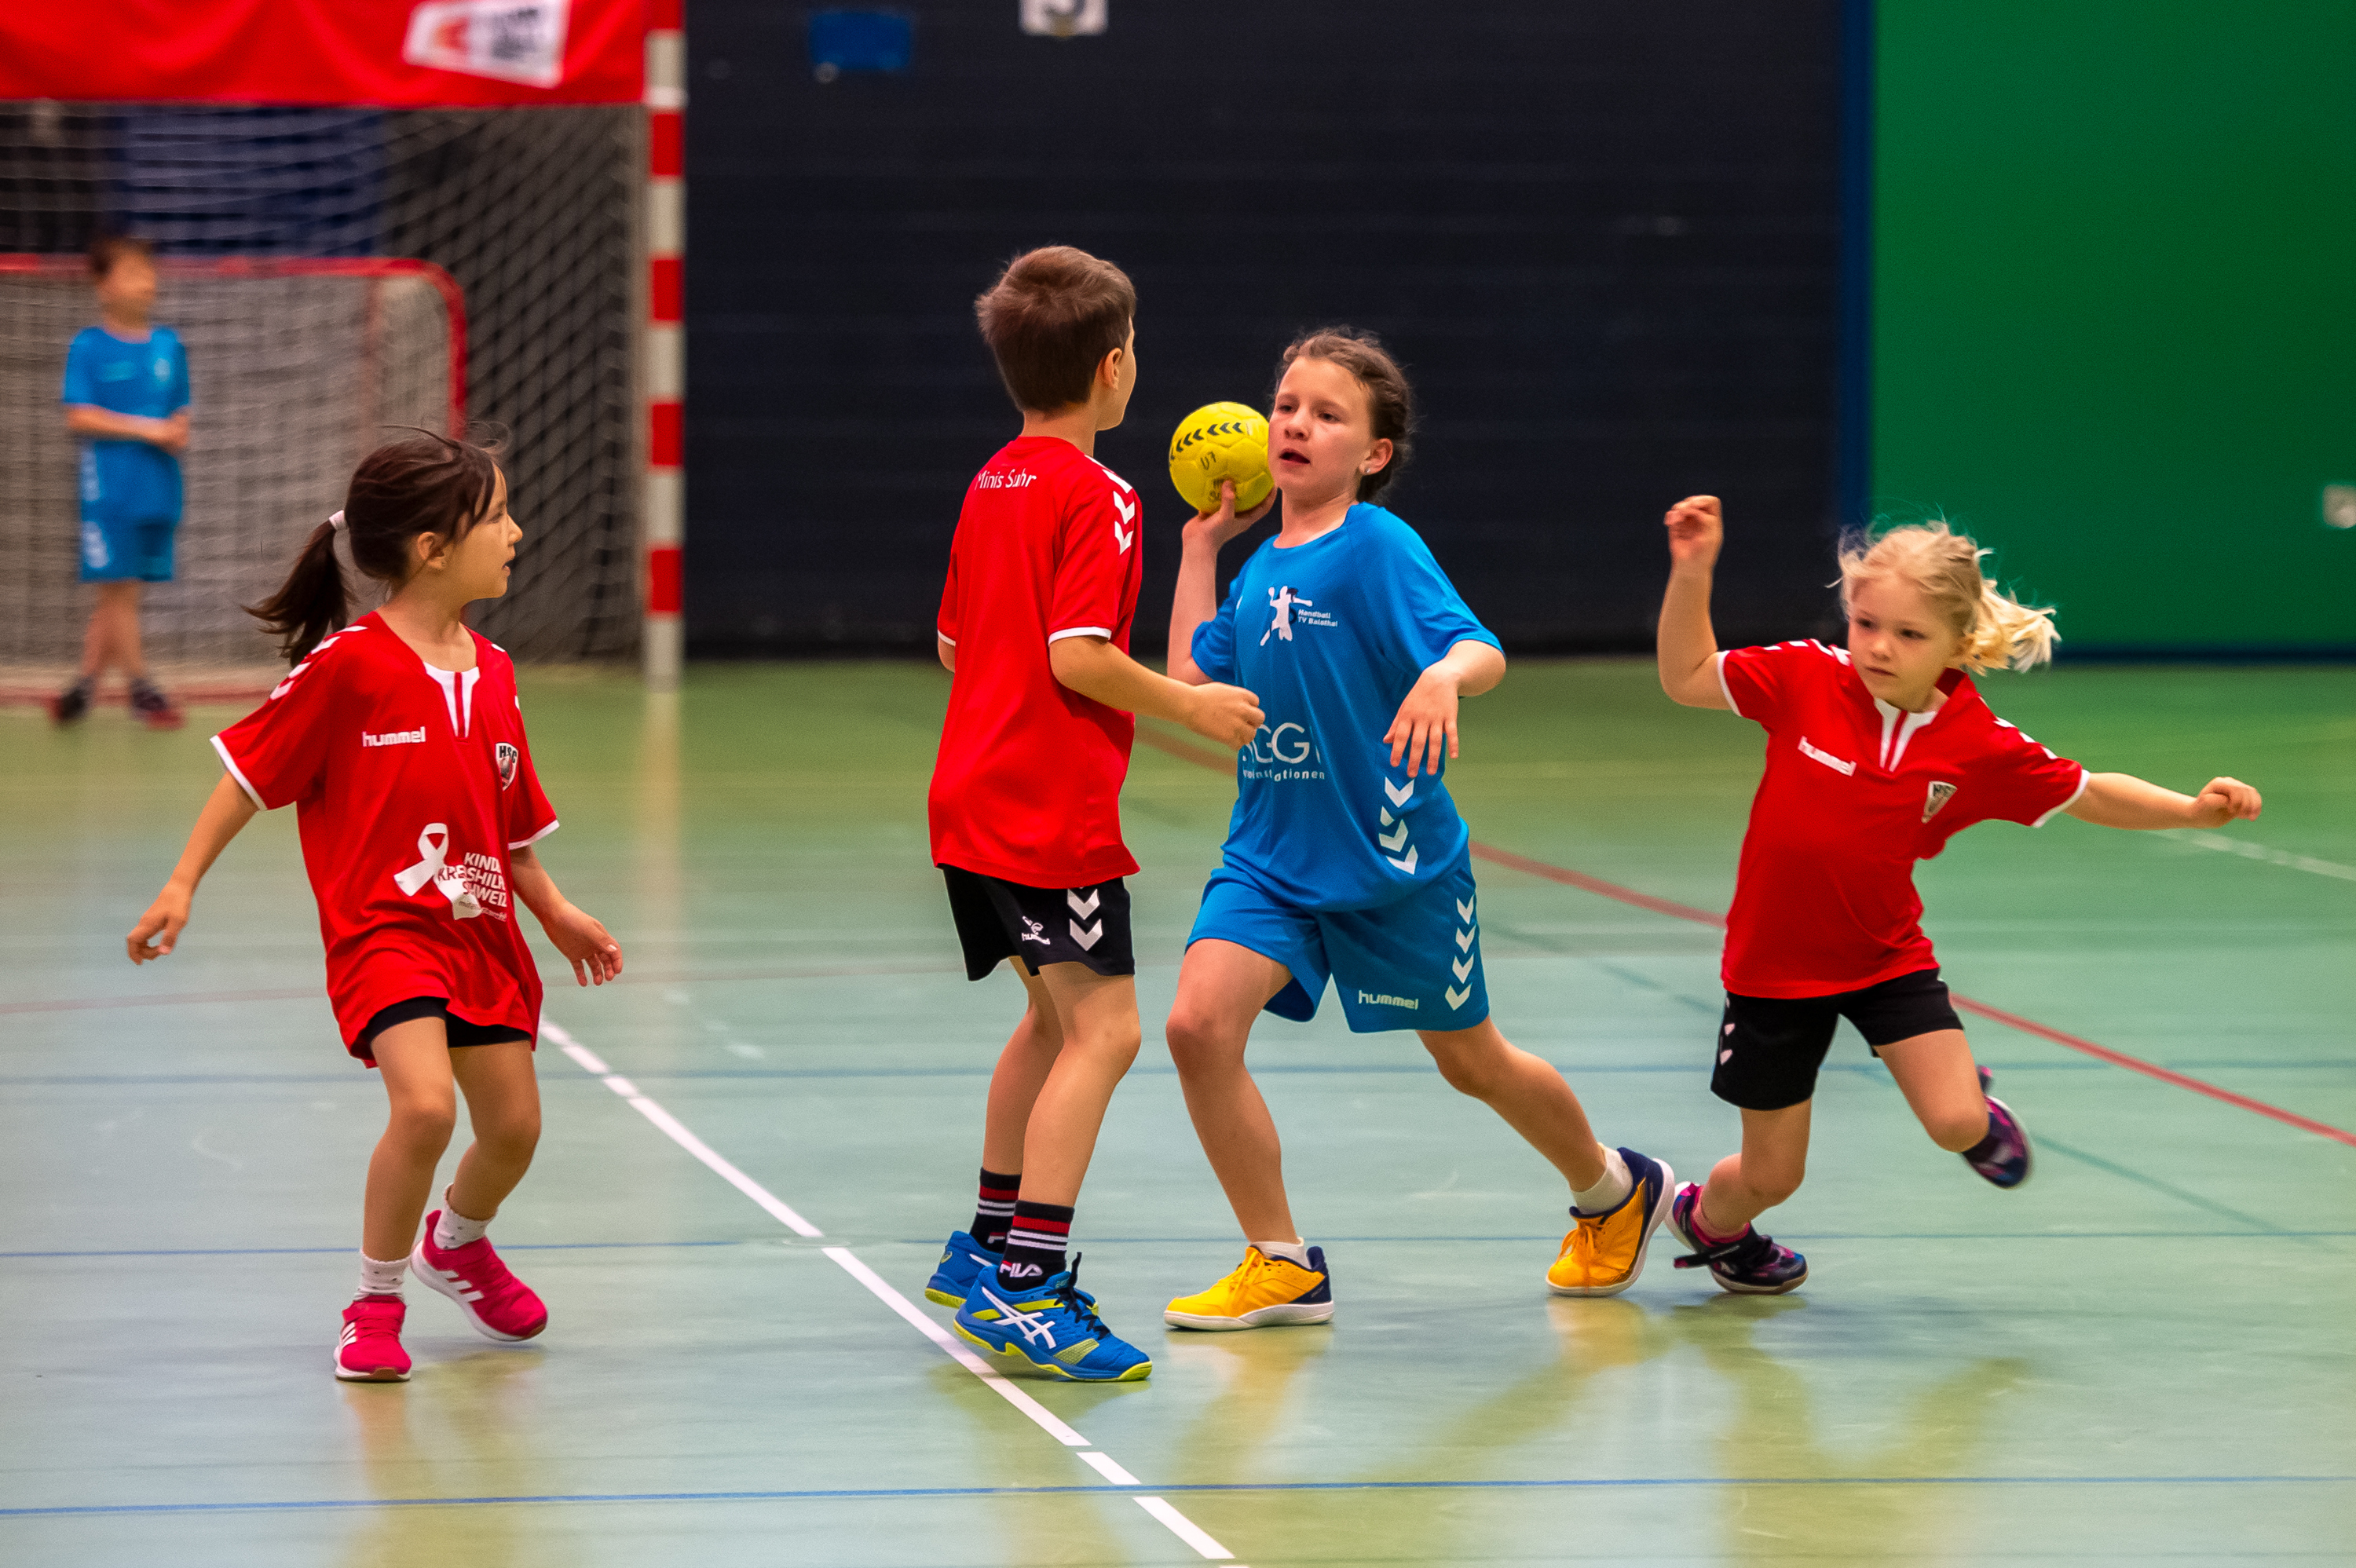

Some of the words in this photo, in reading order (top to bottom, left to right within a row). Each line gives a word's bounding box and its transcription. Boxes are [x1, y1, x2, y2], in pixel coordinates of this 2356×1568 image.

[975, 470, 1004, 491] Minis
[1005, 467, 1037, 488] Suhr
[1298, 609, 1331, 620] Handball
[1298, 616, 1308, 624] TV
[362, 726, 426, 748] hummel
[499, 745, 518, 764] HSC
[1797, 735, 1857, 777] hummel
[463, 851, 503, 874] KIND
[1358, 989, 1419, 1011] hummel
[999, 1259, 1044, 1278] FILA
